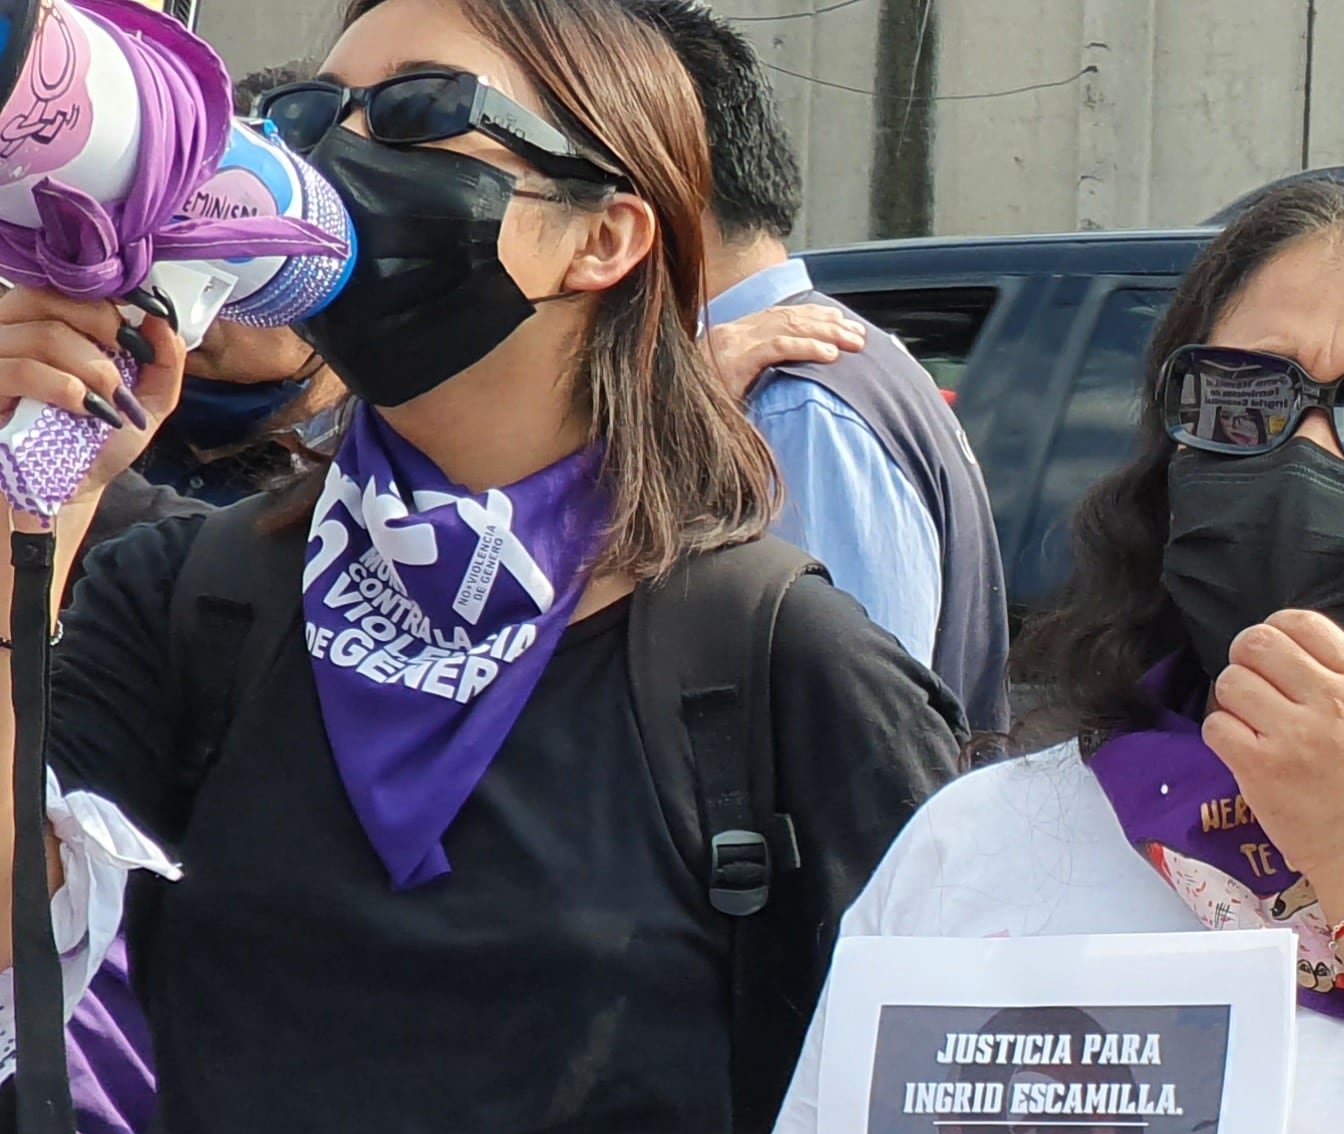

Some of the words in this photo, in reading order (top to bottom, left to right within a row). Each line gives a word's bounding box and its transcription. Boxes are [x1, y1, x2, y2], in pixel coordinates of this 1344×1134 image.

[472, 585, 487, 602] DE
[480, 537, 504, 585] GENERO
[323, 571, 537, 662] VIOLIA
[348, 562, 432, 644] CONTRA
[433, 626, 472, 651] LA
[305, 621, 335, 659] DE
[1240, 843, 1278, 877] TE
[936, 1033, 1072, 1065] JUSTICIA
[1081, 1034, 1161, 1065] PARA
[903, 1082, 1004, 1114] INGRID
[1009, 1083, 1184, 1115] ESCAMILLA.
